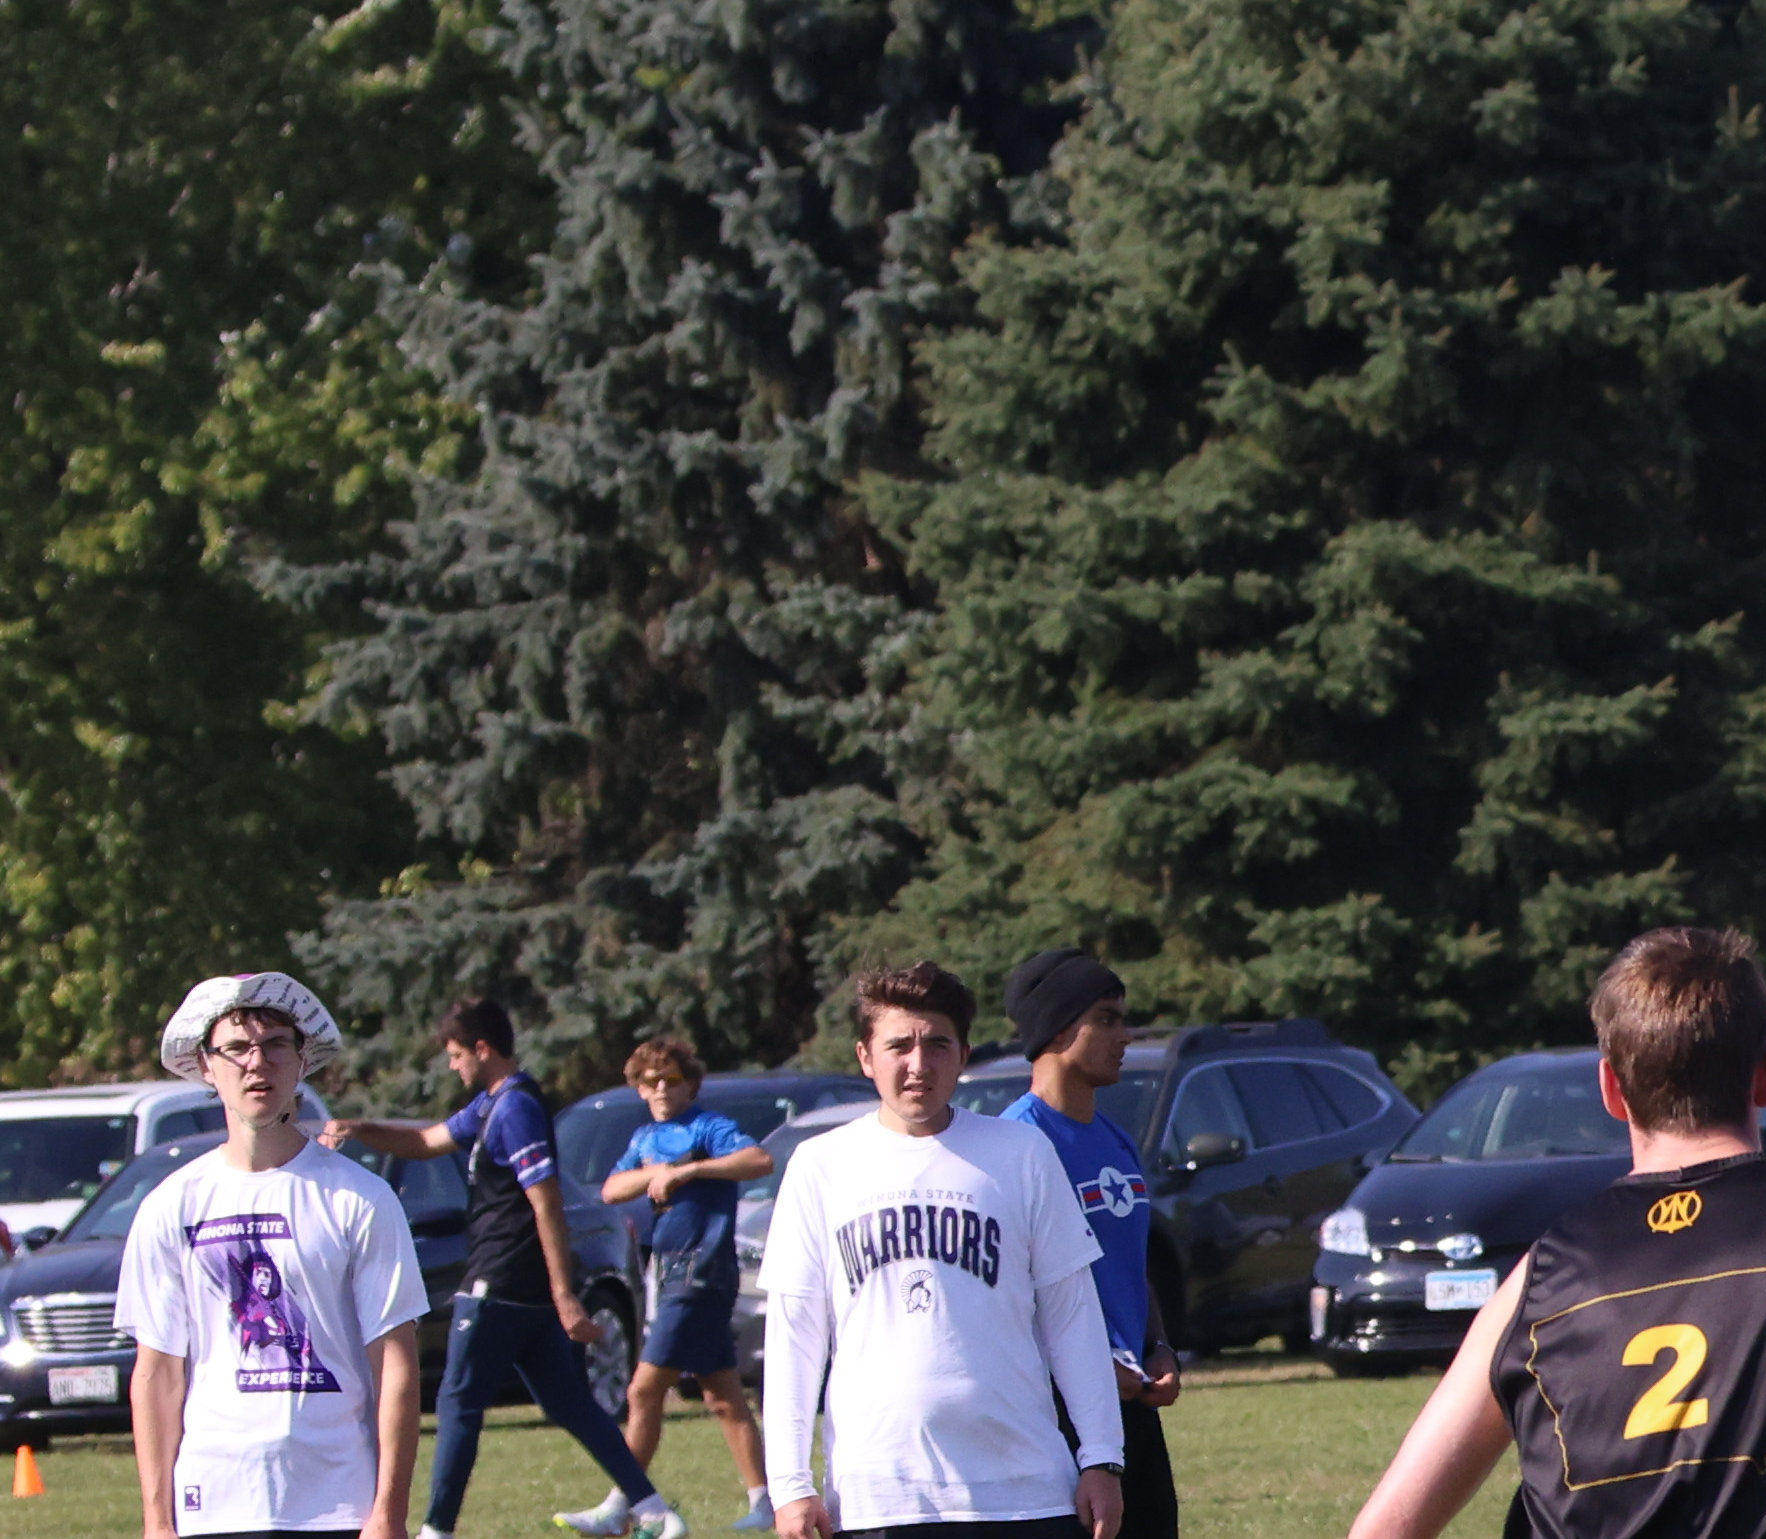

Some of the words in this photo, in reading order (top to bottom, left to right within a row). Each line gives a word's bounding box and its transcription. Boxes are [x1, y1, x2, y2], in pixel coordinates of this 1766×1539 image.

[926, 1189, 976, 1204] STATE
[247, 1221, 285, 1235] STATE
[836, 1205, 1001, 1296] WARRIORS
[1622, 1323, 1708, 1439] 2
